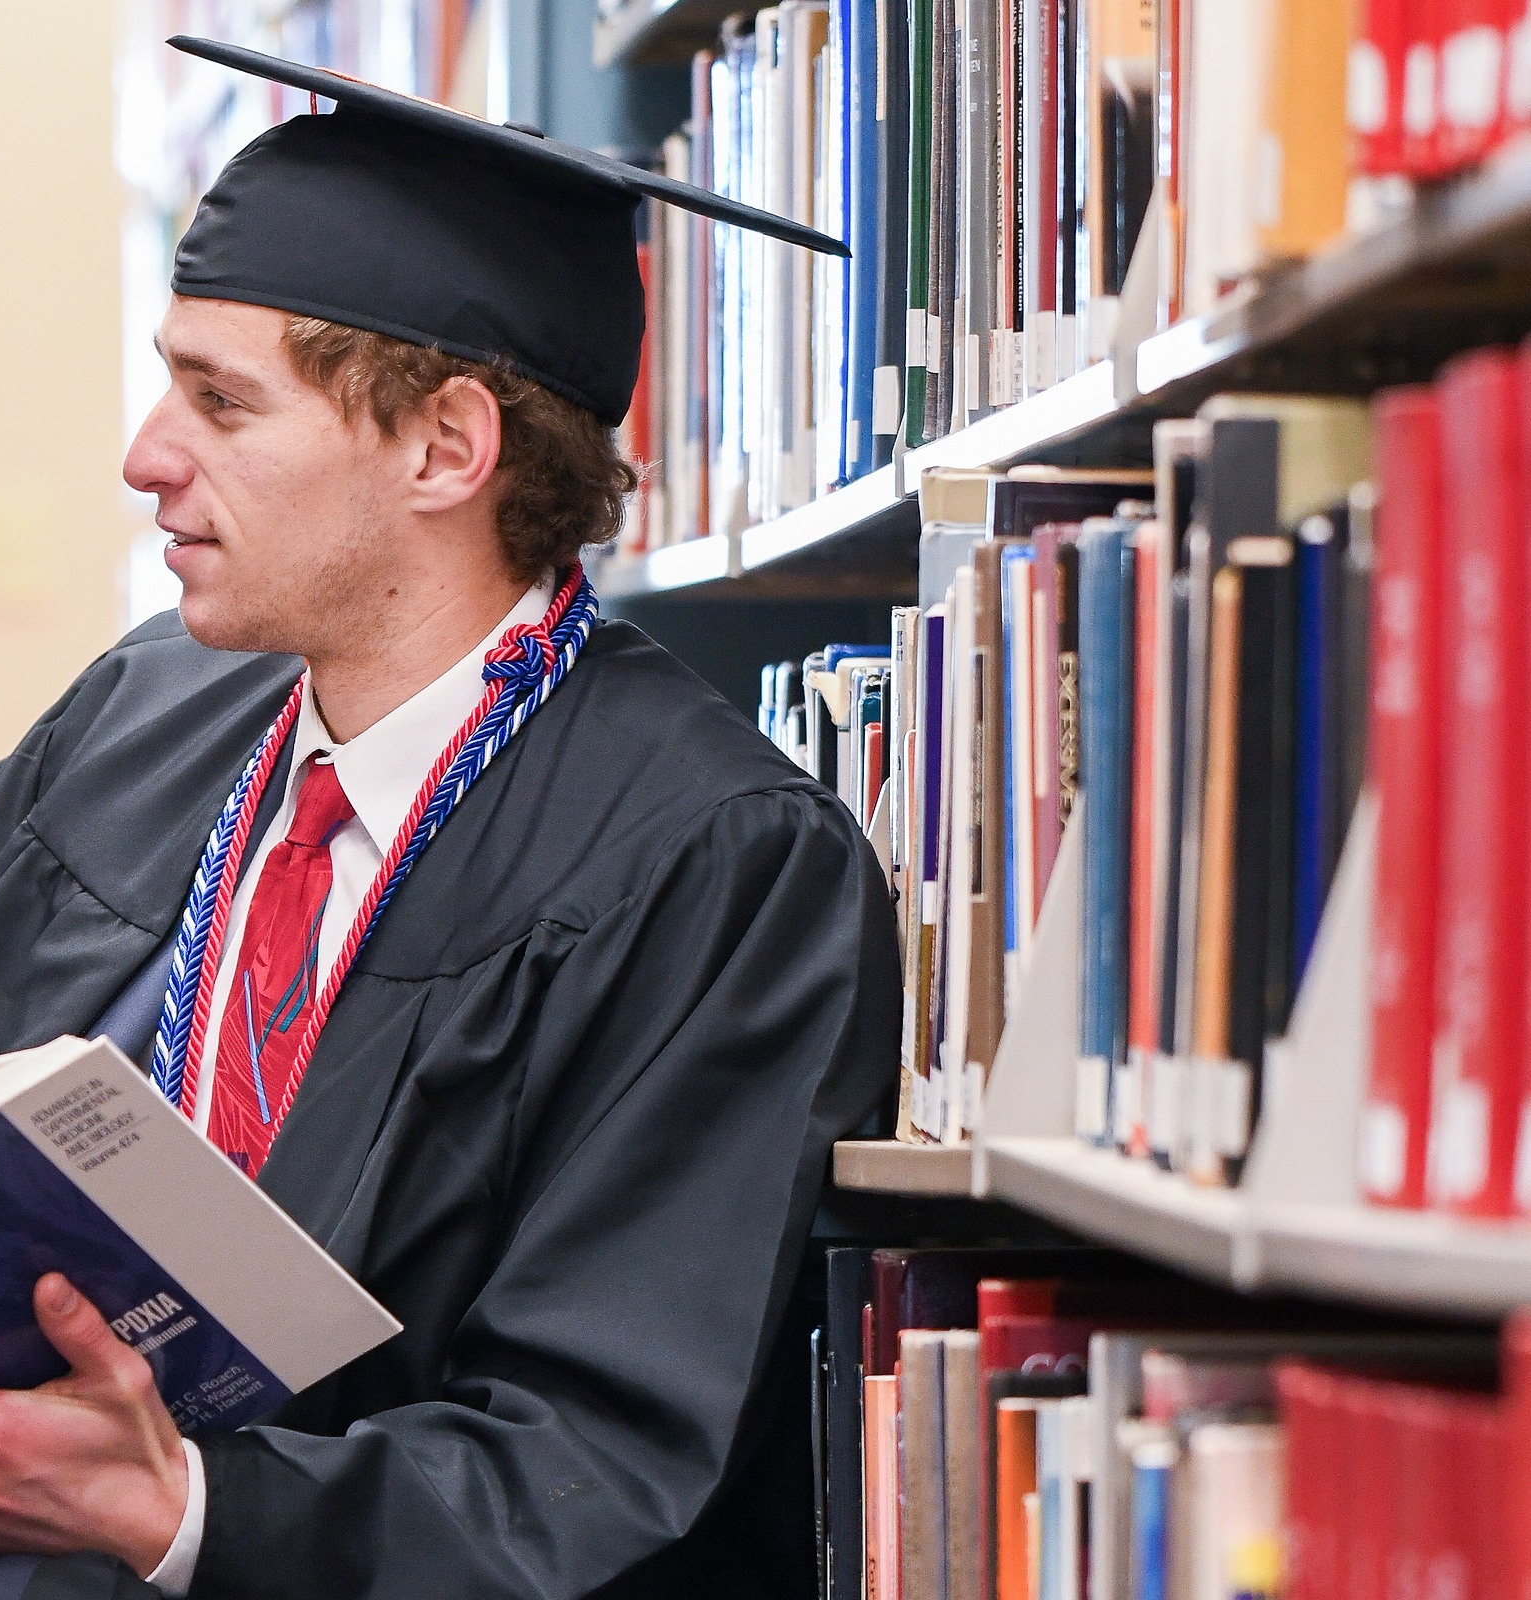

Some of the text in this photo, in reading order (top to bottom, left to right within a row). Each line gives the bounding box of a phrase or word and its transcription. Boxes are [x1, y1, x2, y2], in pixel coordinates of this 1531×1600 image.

[31, 1084, 91, 1125] ADVANCES
[40, 1087, 121, 1137] EXPERIMENTAL
[52, 1111, 104, 1148] MEDICINE
[87, 1111, 134, 1143] BIOLOGY
[77, 1131, 141, 1172] Volume 474
[110, 1291, 183, 1342] POXIA
